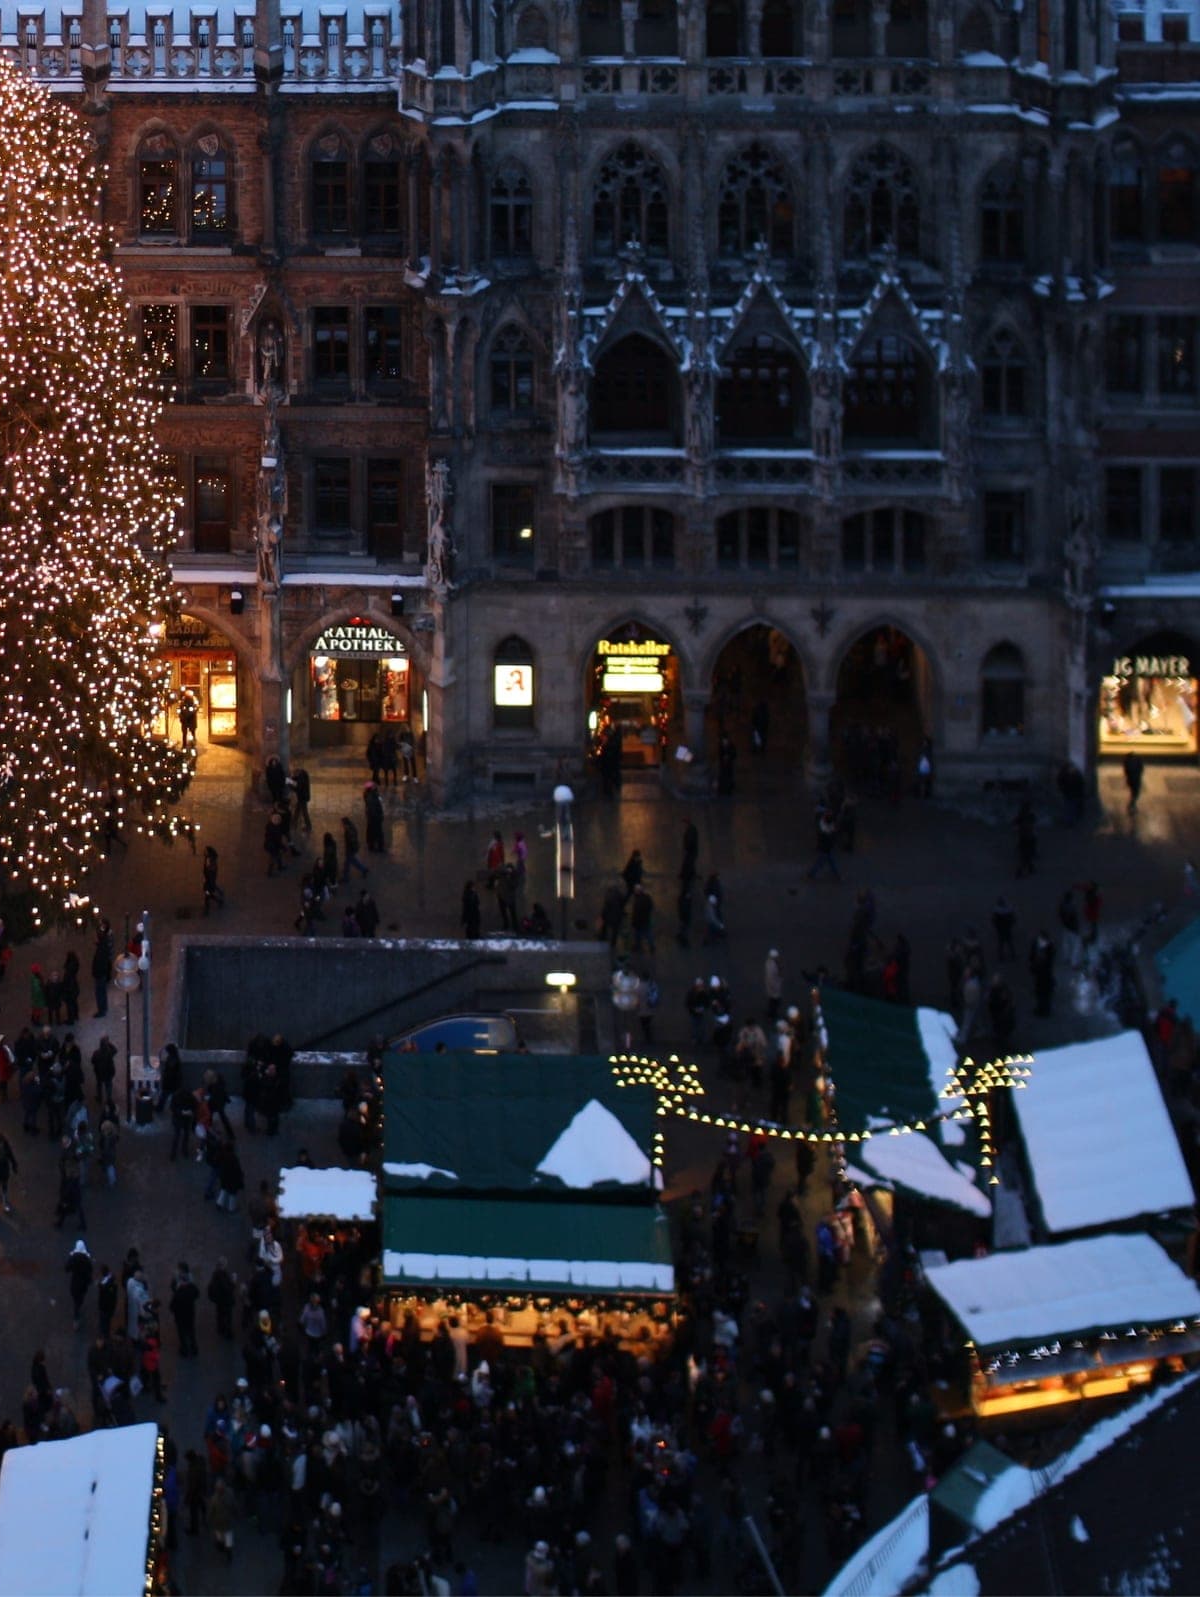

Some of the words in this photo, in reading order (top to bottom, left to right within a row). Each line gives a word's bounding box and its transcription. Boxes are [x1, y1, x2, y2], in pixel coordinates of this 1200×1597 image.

[324, 627, 394, 639] RATHAU
[314, 637, 405, 652] APOTHEKE
[598, 640, 670, 655] Ratskeller
[1136, 655, 1190, 675] MAYER
